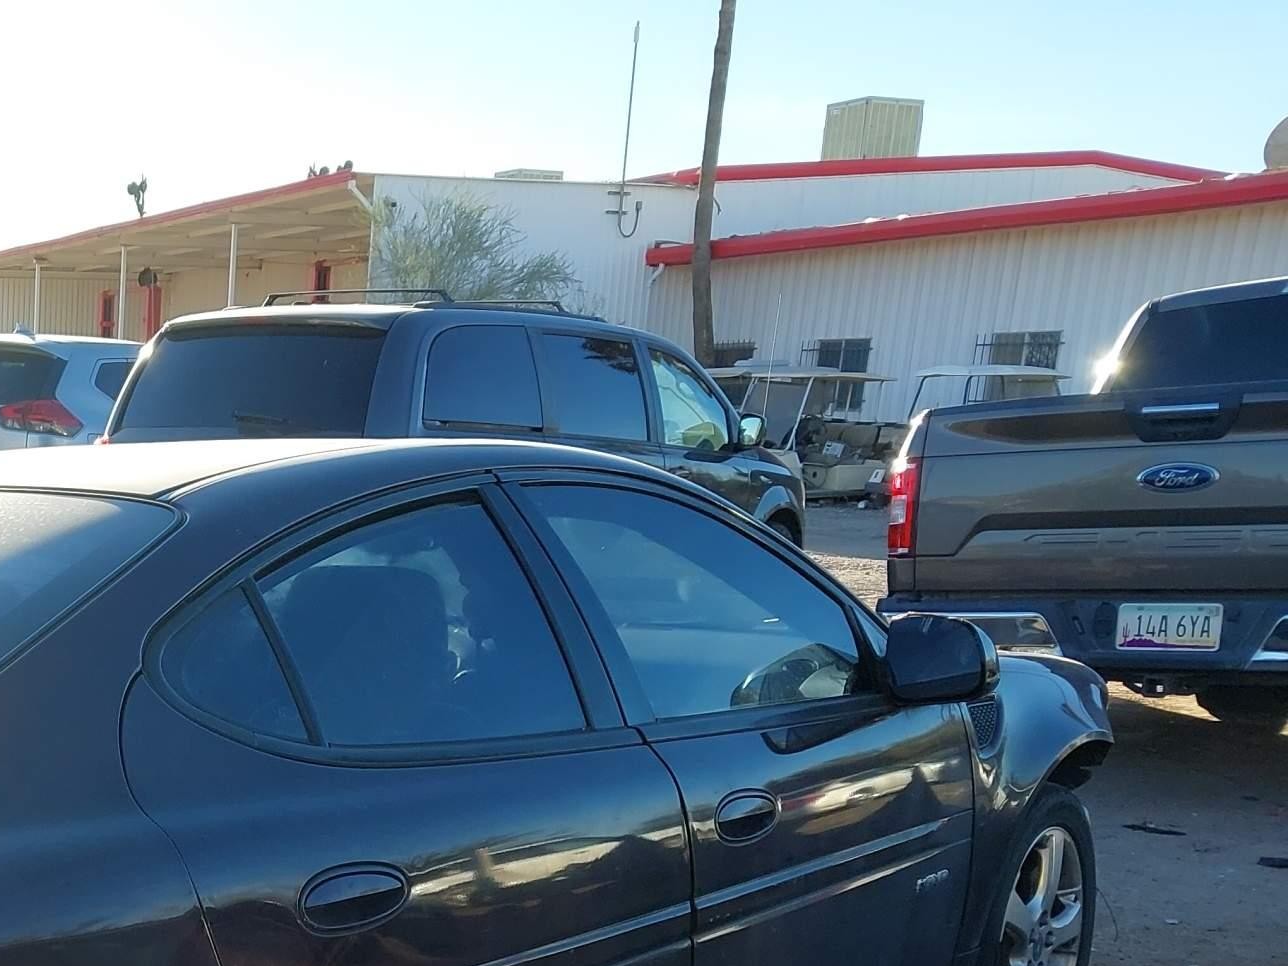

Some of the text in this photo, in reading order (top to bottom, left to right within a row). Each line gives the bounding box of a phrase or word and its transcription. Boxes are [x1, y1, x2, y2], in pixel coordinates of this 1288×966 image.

[1155, 469, 1200, 486] Ford
[1134, 615, 1211, 638] 14A 6YA
